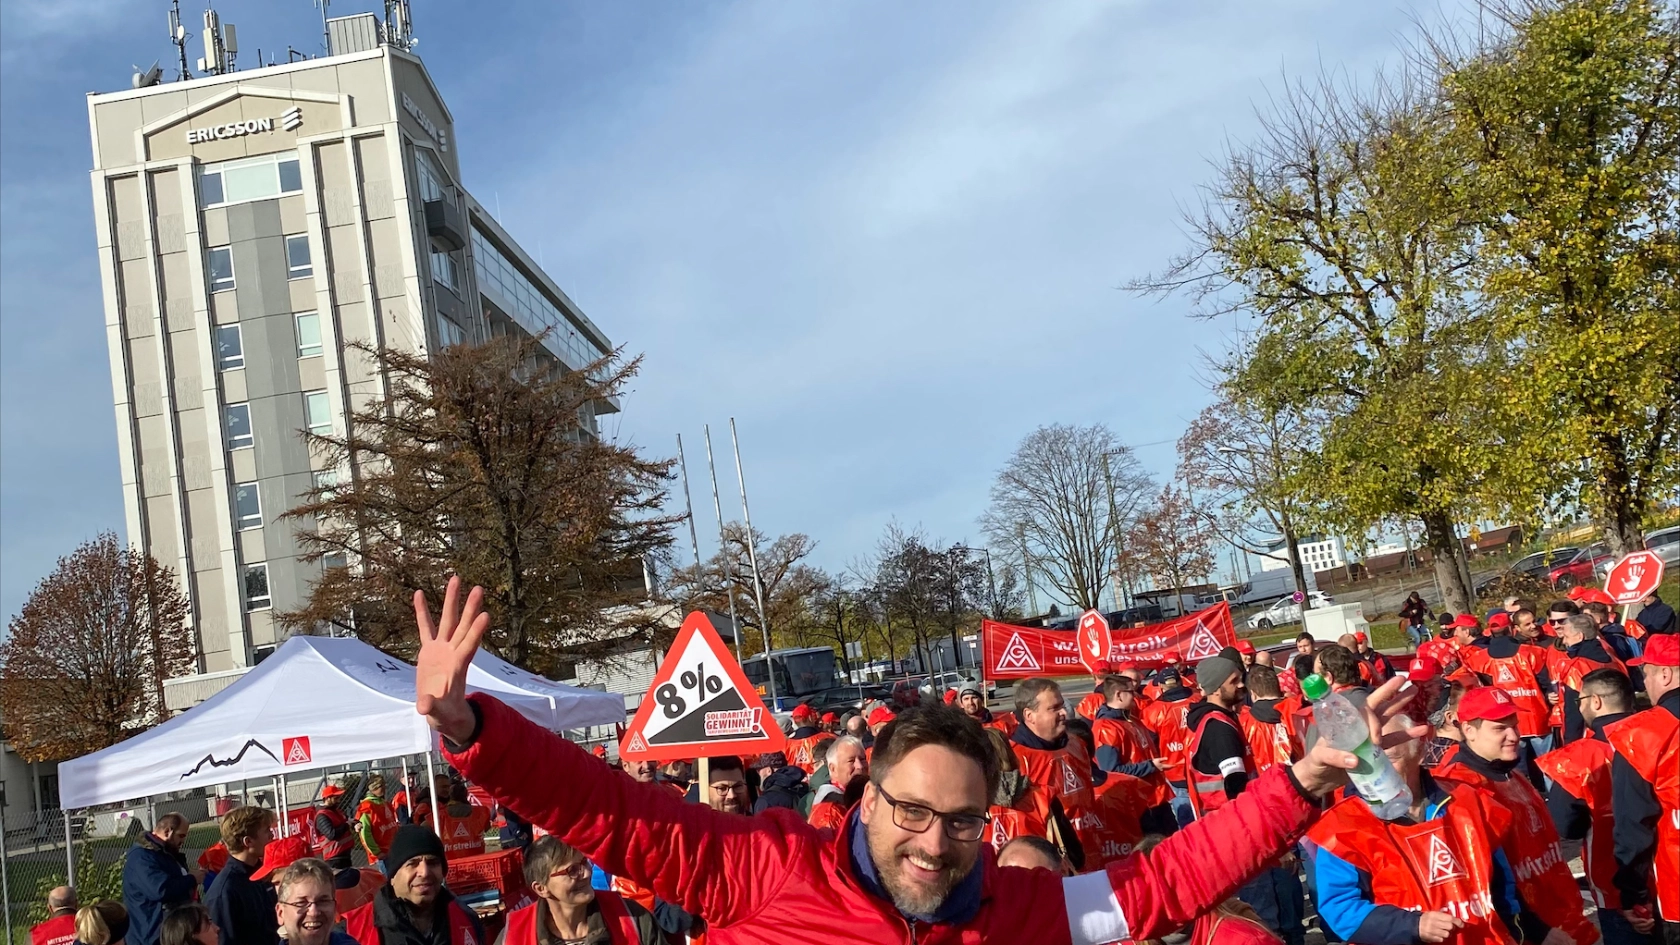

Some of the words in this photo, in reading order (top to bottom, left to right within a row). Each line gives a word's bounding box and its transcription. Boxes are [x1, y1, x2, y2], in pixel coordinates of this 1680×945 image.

[186, 117, 271, 143] ERICSSON
[402, 91, 438, 142] ERICSSON
[656, 661, 723, 719] 8%
[706, 709, 752, 721] SOLIDARITÄT
